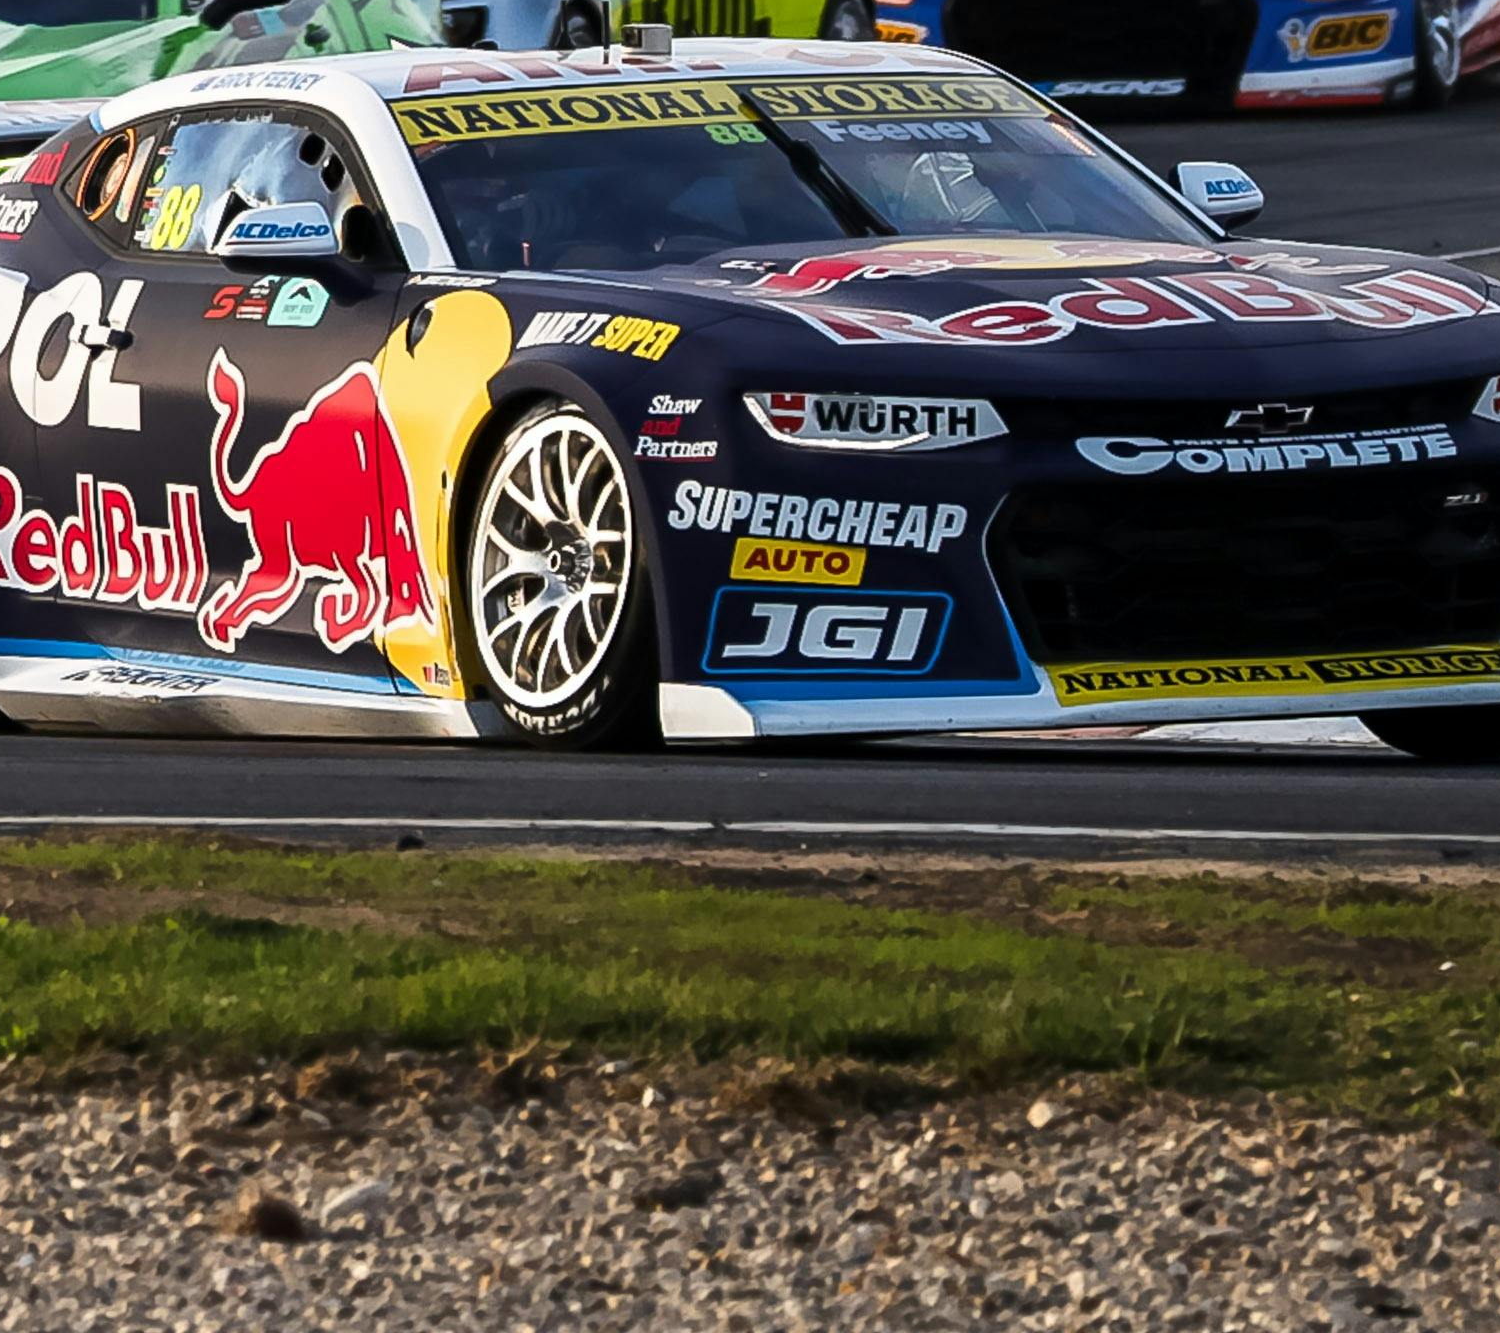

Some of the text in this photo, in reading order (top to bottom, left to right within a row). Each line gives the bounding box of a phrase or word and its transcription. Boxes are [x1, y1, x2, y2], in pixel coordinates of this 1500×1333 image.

[1312, 16, 1390, 53] BIC
[402, 78, 1030, 142] NATIONAL STORAGE
[703, 121, 768, 147] 88
[819, 116, 992, 147] Feeney
[150, 183, 202, 251] 88
[231, 221, 332, 240] ACDelco
[591, 315, 682, 362] SUPER
[648, 394, 703, 416] Shaw
[812, 399, 978, 437] WÜRTH
[640, 416, 683, 436] and
[633, 435, 719, 460] Partners
[668, 480, 968, 553] SUPERCHEAP
[743, 548, 852, 576] AUTO
[720, 602, 930, 661] JGI
[1063, 663, 1310, 696] NATIONAL
